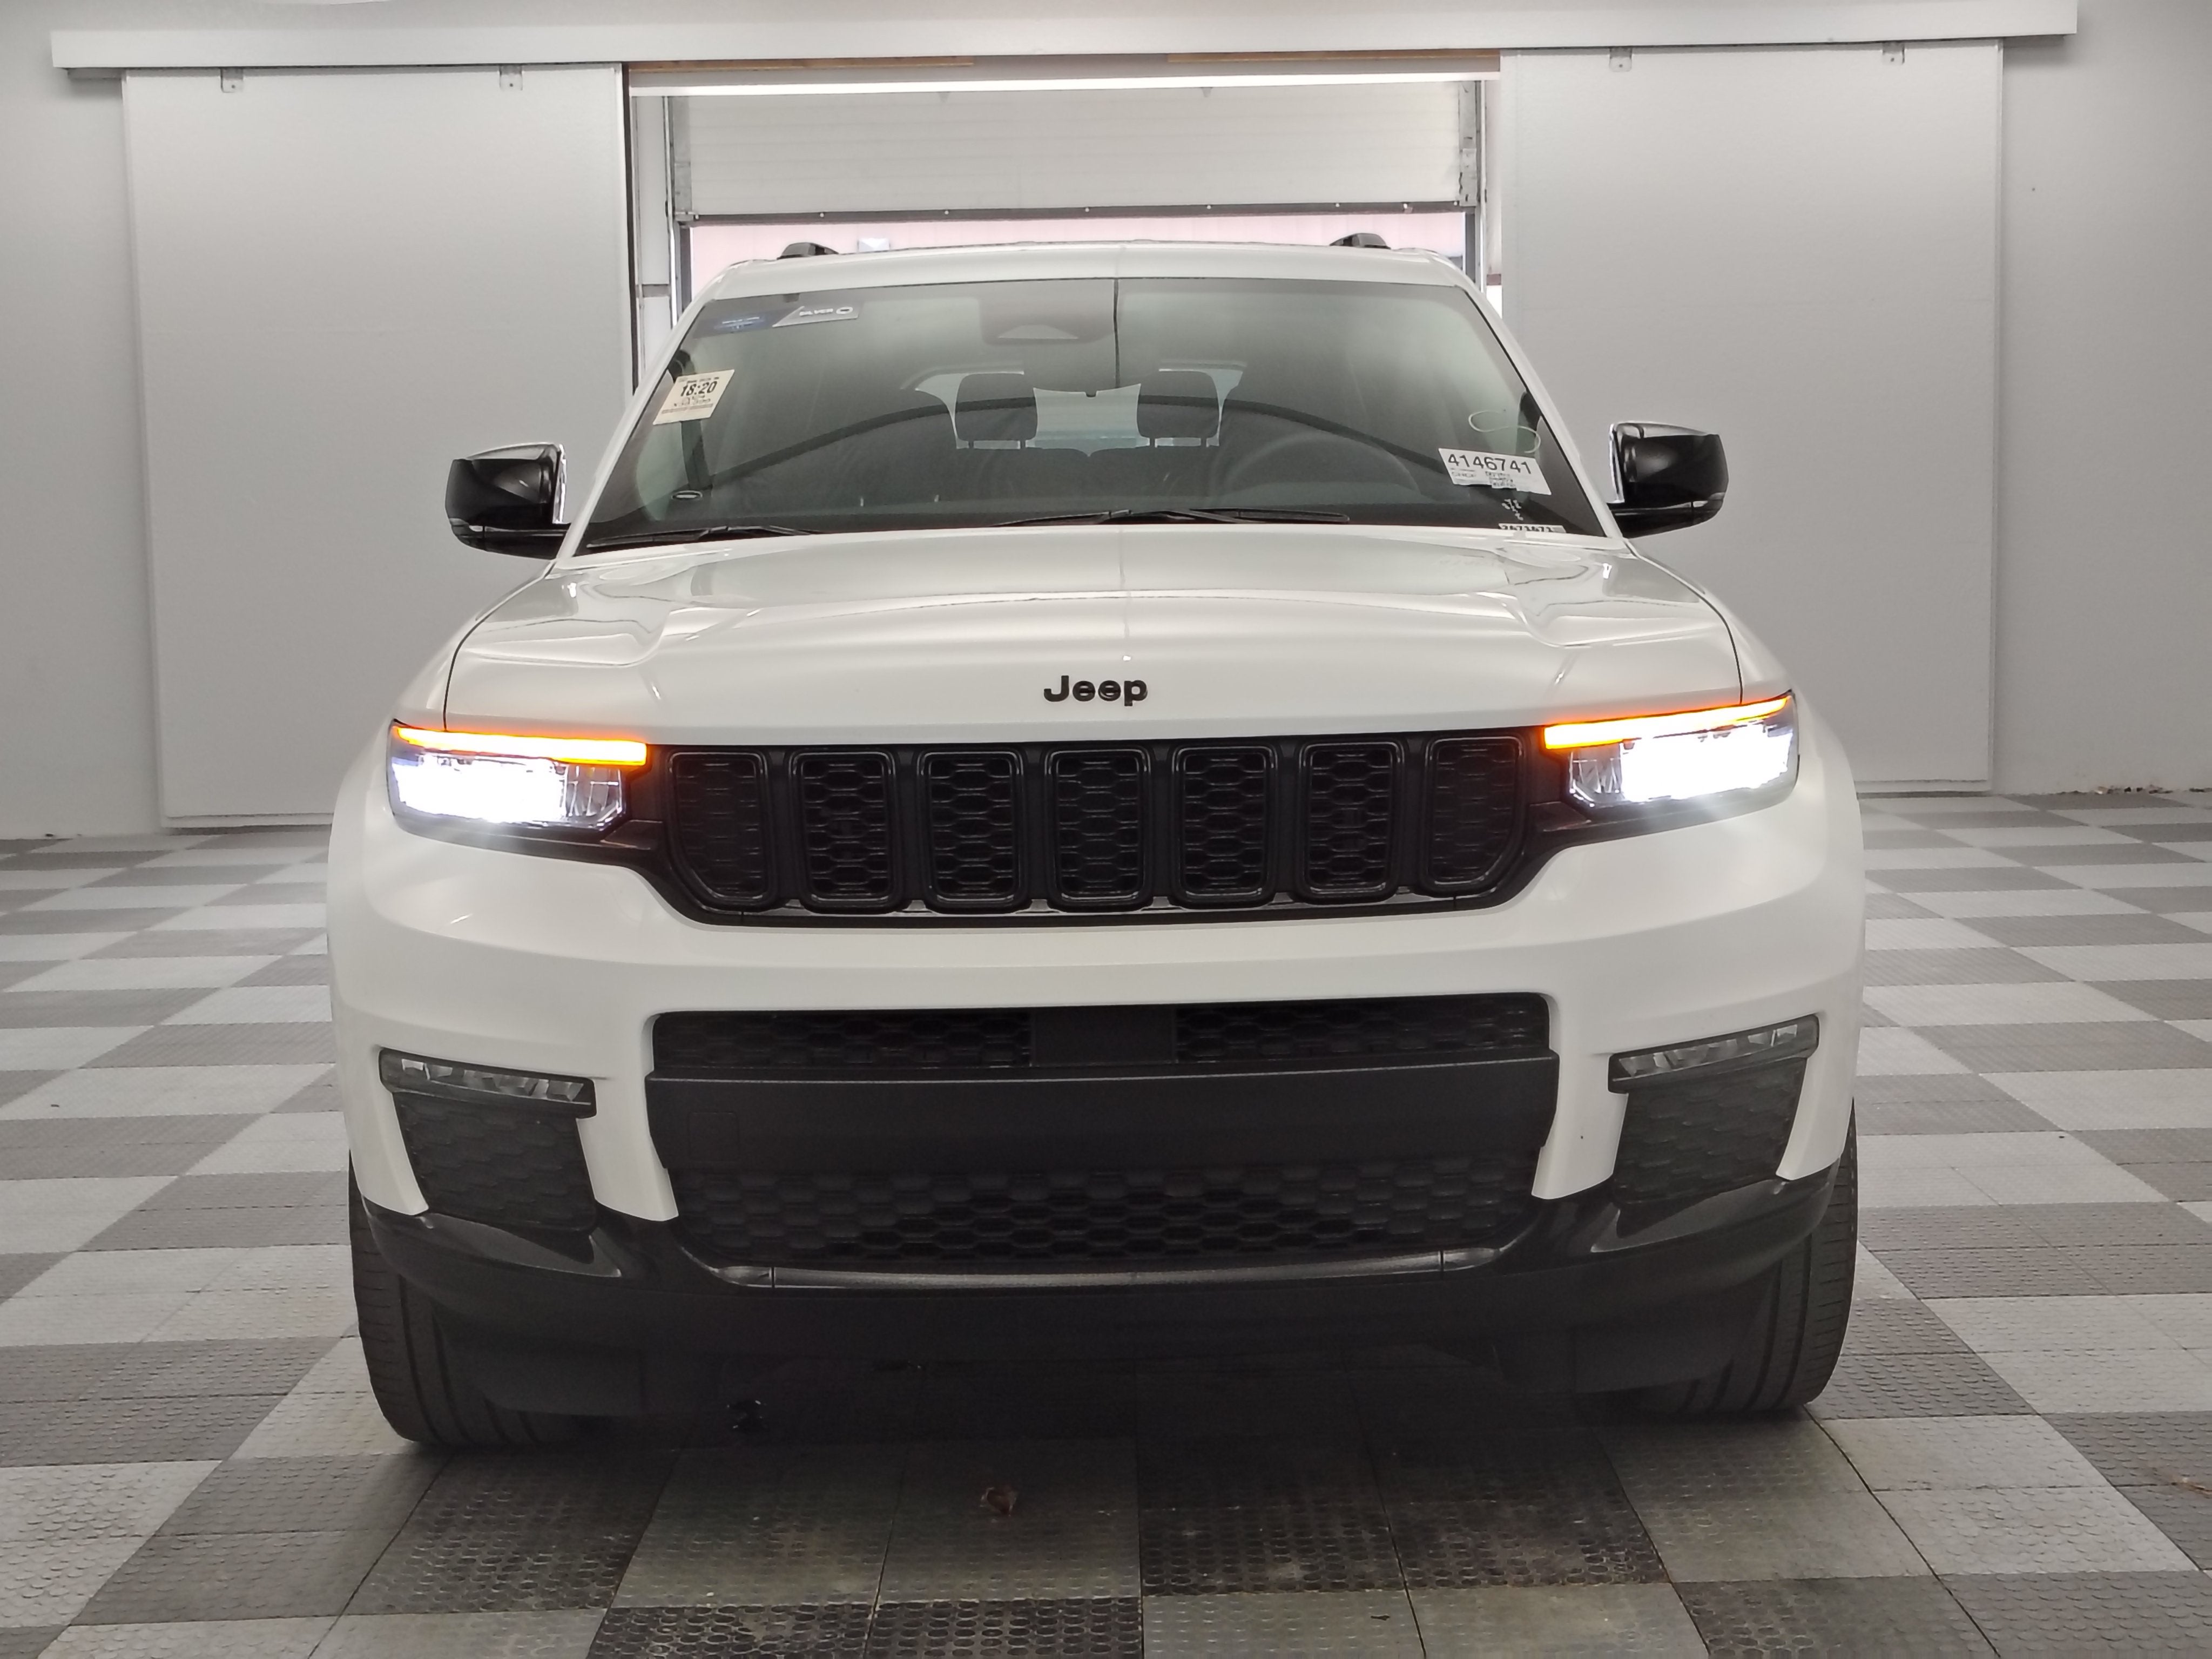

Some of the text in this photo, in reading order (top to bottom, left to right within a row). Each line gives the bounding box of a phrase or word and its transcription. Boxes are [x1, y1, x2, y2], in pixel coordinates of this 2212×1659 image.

[680, 381, 718, 397] 18:20
[1448, 454, 1532, 474] 4146741
[1043, 675, 1148, 706] Jeep
